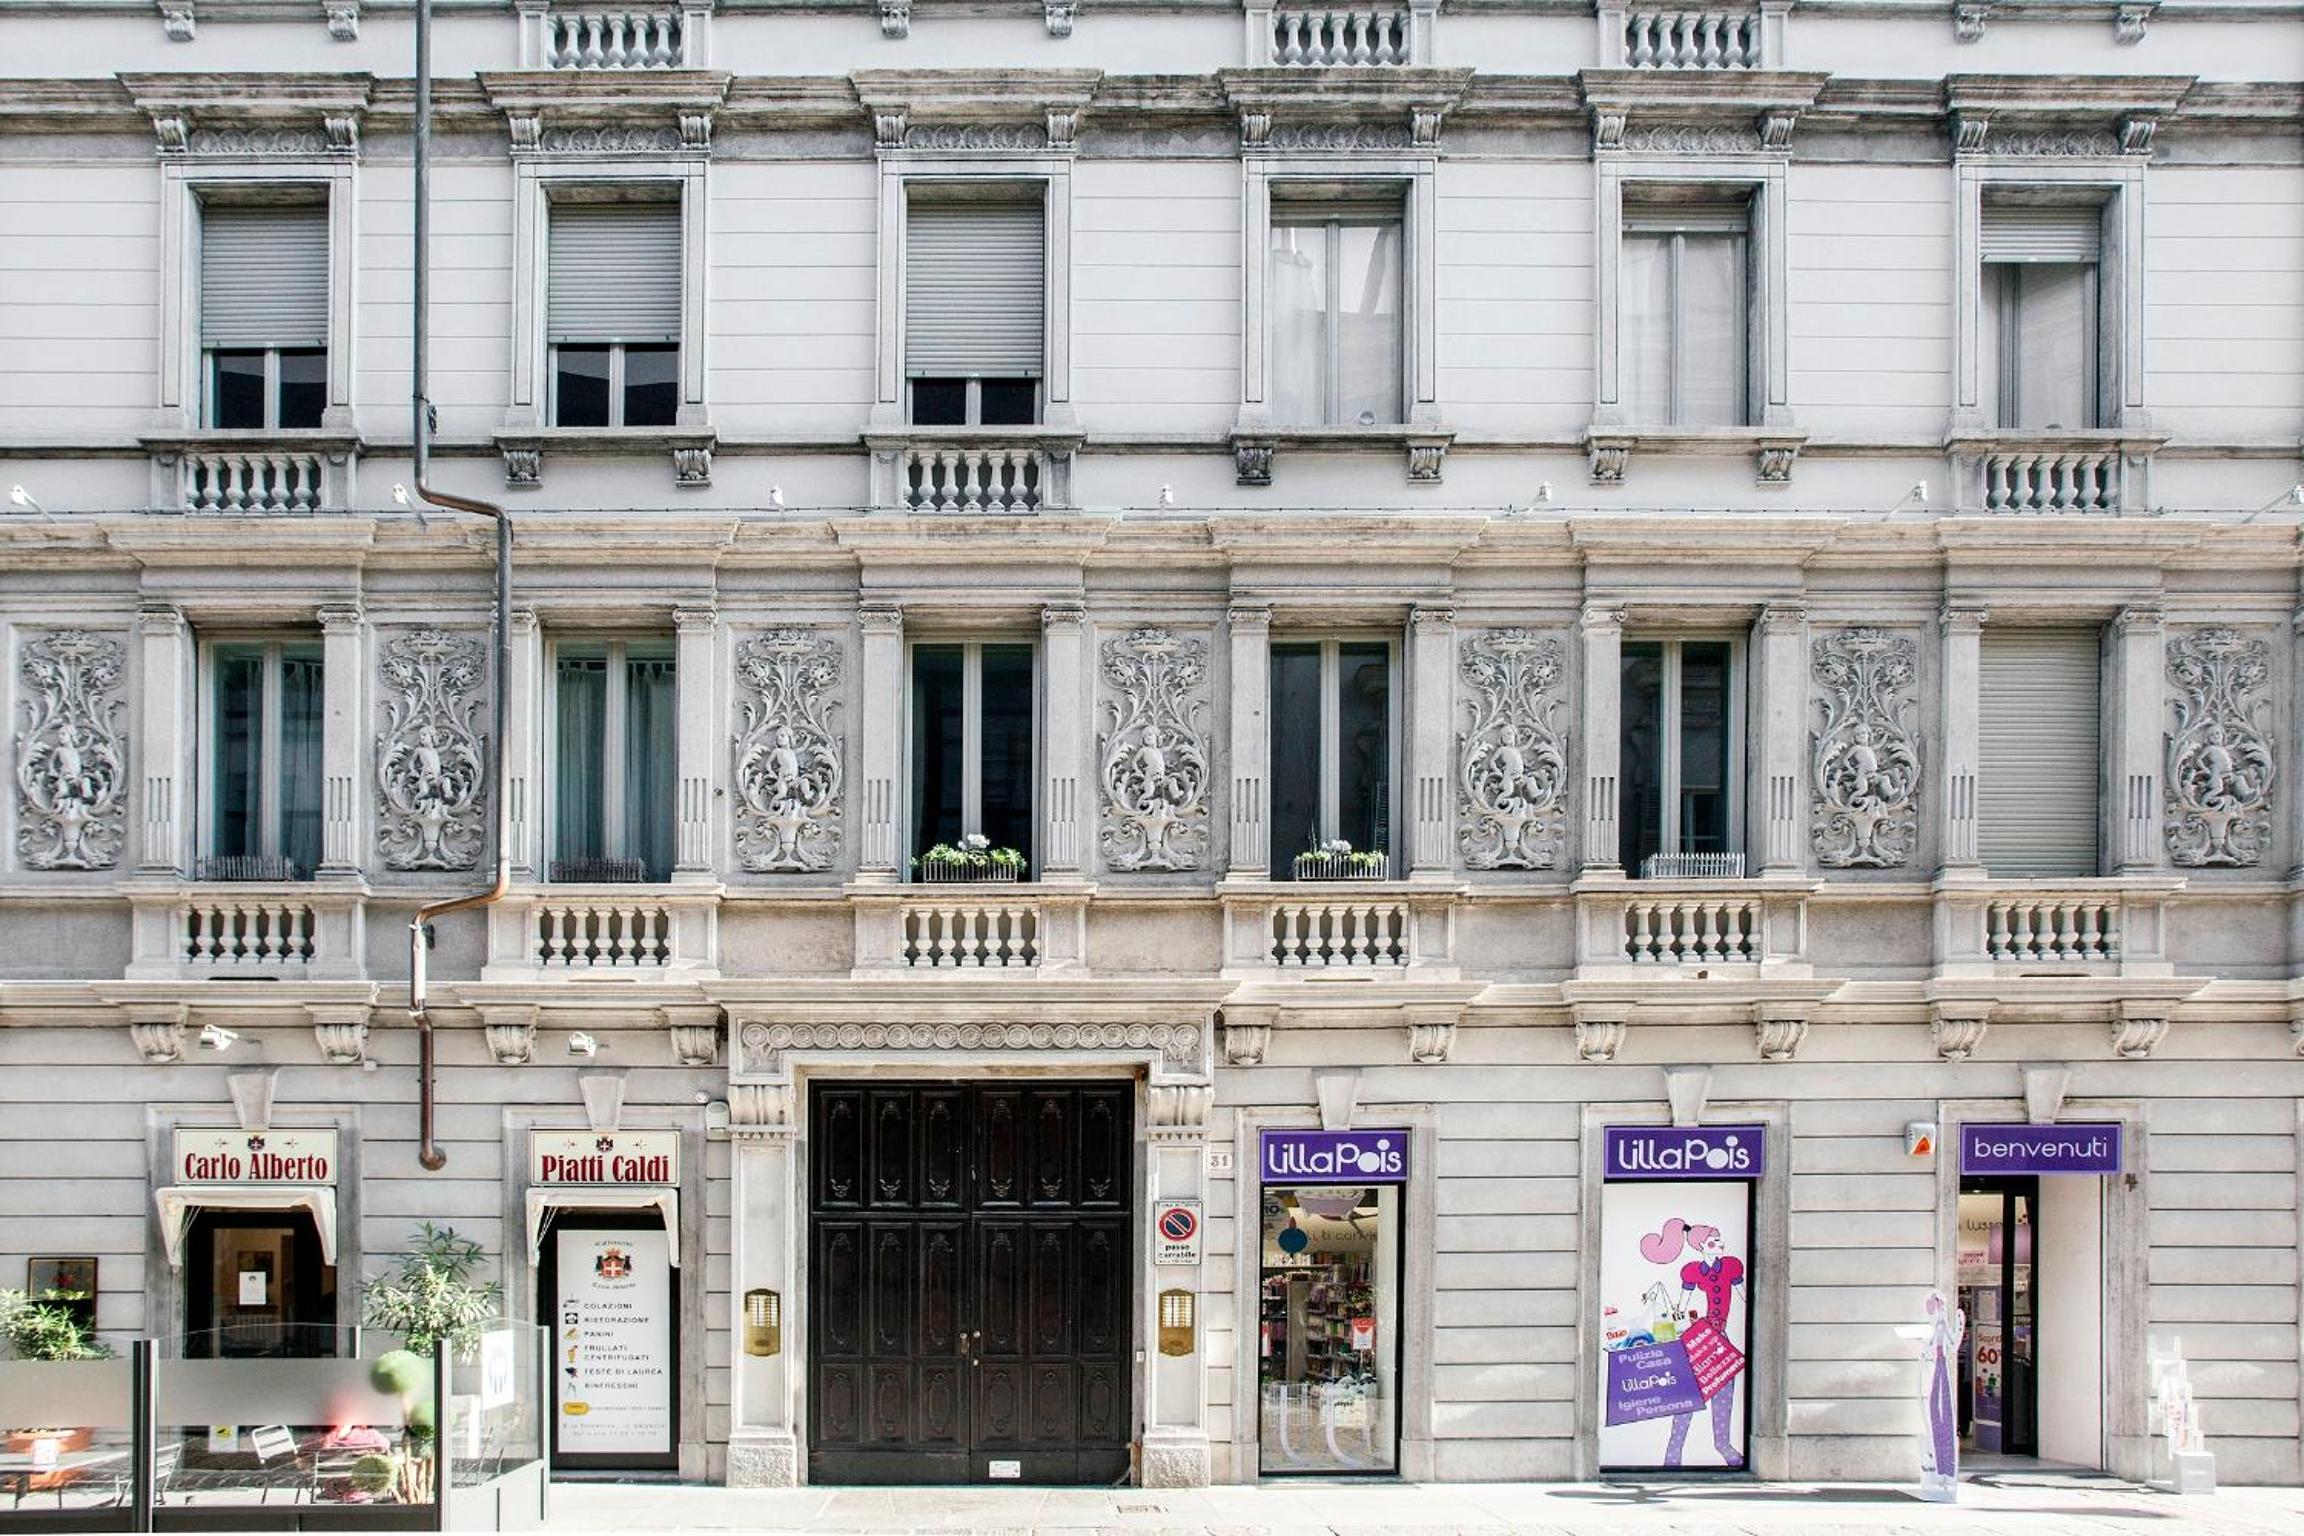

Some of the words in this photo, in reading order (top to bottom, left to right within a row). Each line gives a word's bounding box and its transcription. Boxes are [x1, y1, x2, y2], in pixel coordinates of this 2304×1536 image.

[1975, 1136, 2107, 1157] benvenuti
[185, 1153, 240, 1180] Carlo
[249, 1153, 327, 1180] Alberto
[541, 1155, 604, 1182] Piatti
[612, 1155, 669, 1182] Caldi
[1210, 1155, 1228, 1168] 31
[1618, 1349, 1664, 1364] Pulizia
[1636, 1357, 1671, 1369] Casa
[1699, 1352, 1737, 1384] Bellezza
[1618, 1396, 1661, 1411] Igiene
[1636, 1400, 1693, 1416] Persona
